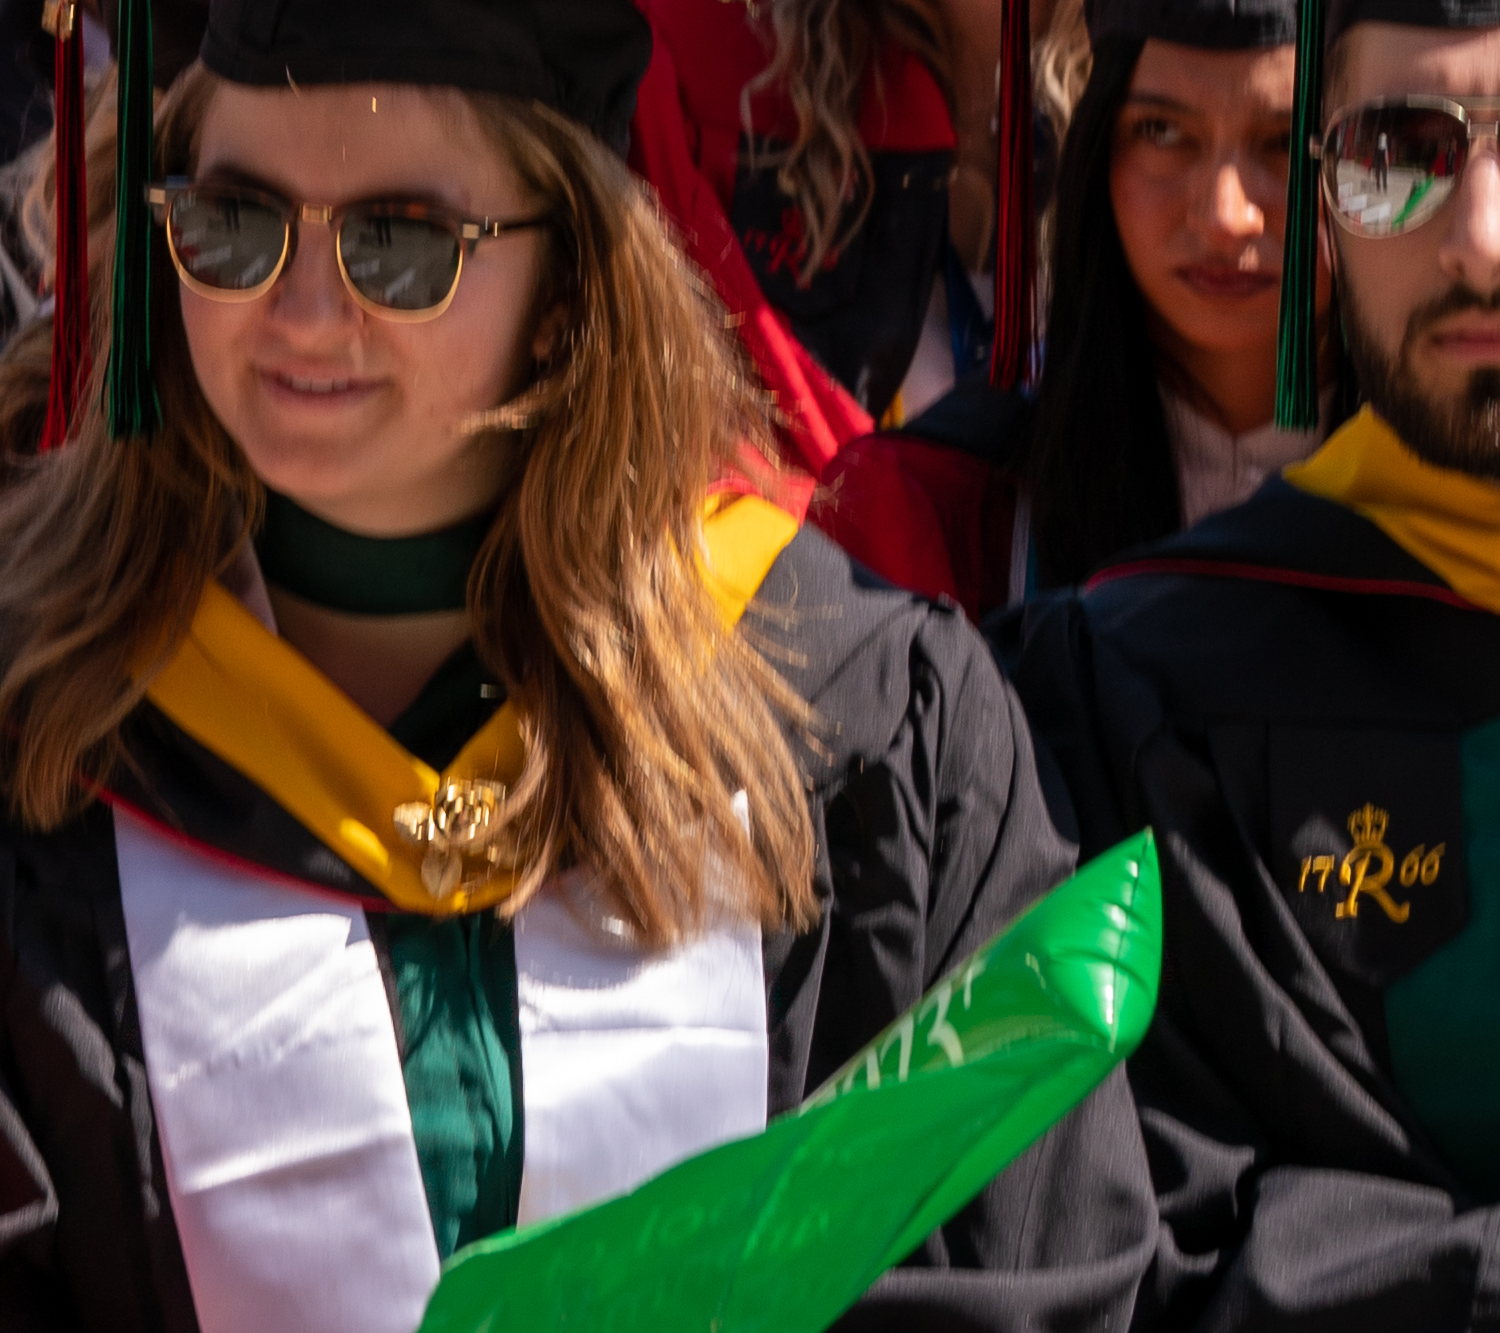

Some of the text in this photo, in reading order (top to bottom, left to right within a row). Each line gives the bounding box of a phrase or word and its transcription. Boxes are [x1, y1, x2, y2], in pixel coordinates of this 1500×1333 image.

[1298, 842, 1446, 924] 17 R 66
